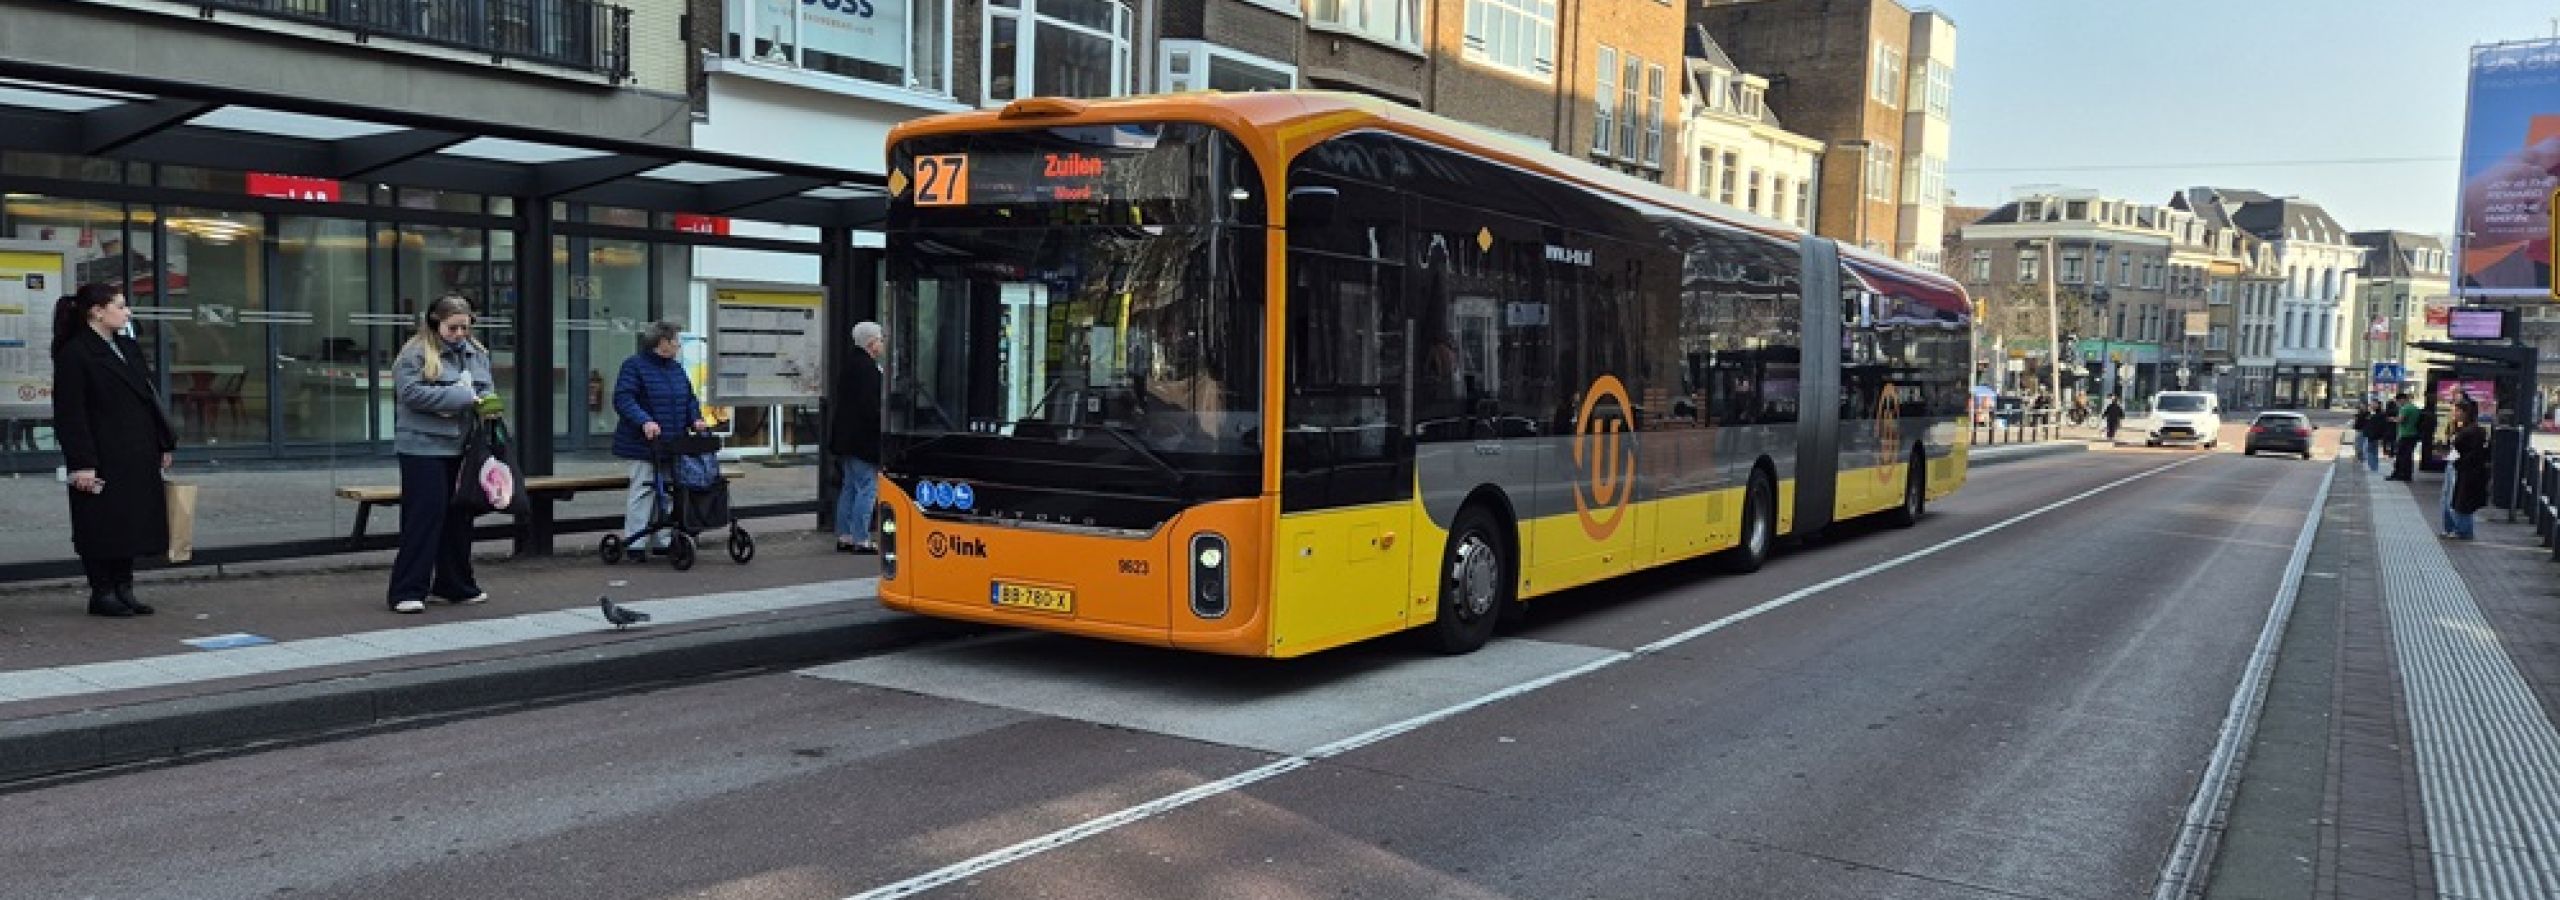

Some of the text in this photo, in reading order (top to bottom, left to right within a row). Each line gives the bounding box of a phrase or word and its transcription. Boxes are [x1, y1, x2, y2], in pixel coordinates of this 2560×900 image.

[1044, 153, 1103, 176] Zuilen
[918, 157, 964, 201] 27
[1118, 558, 1150, 576] 9623
